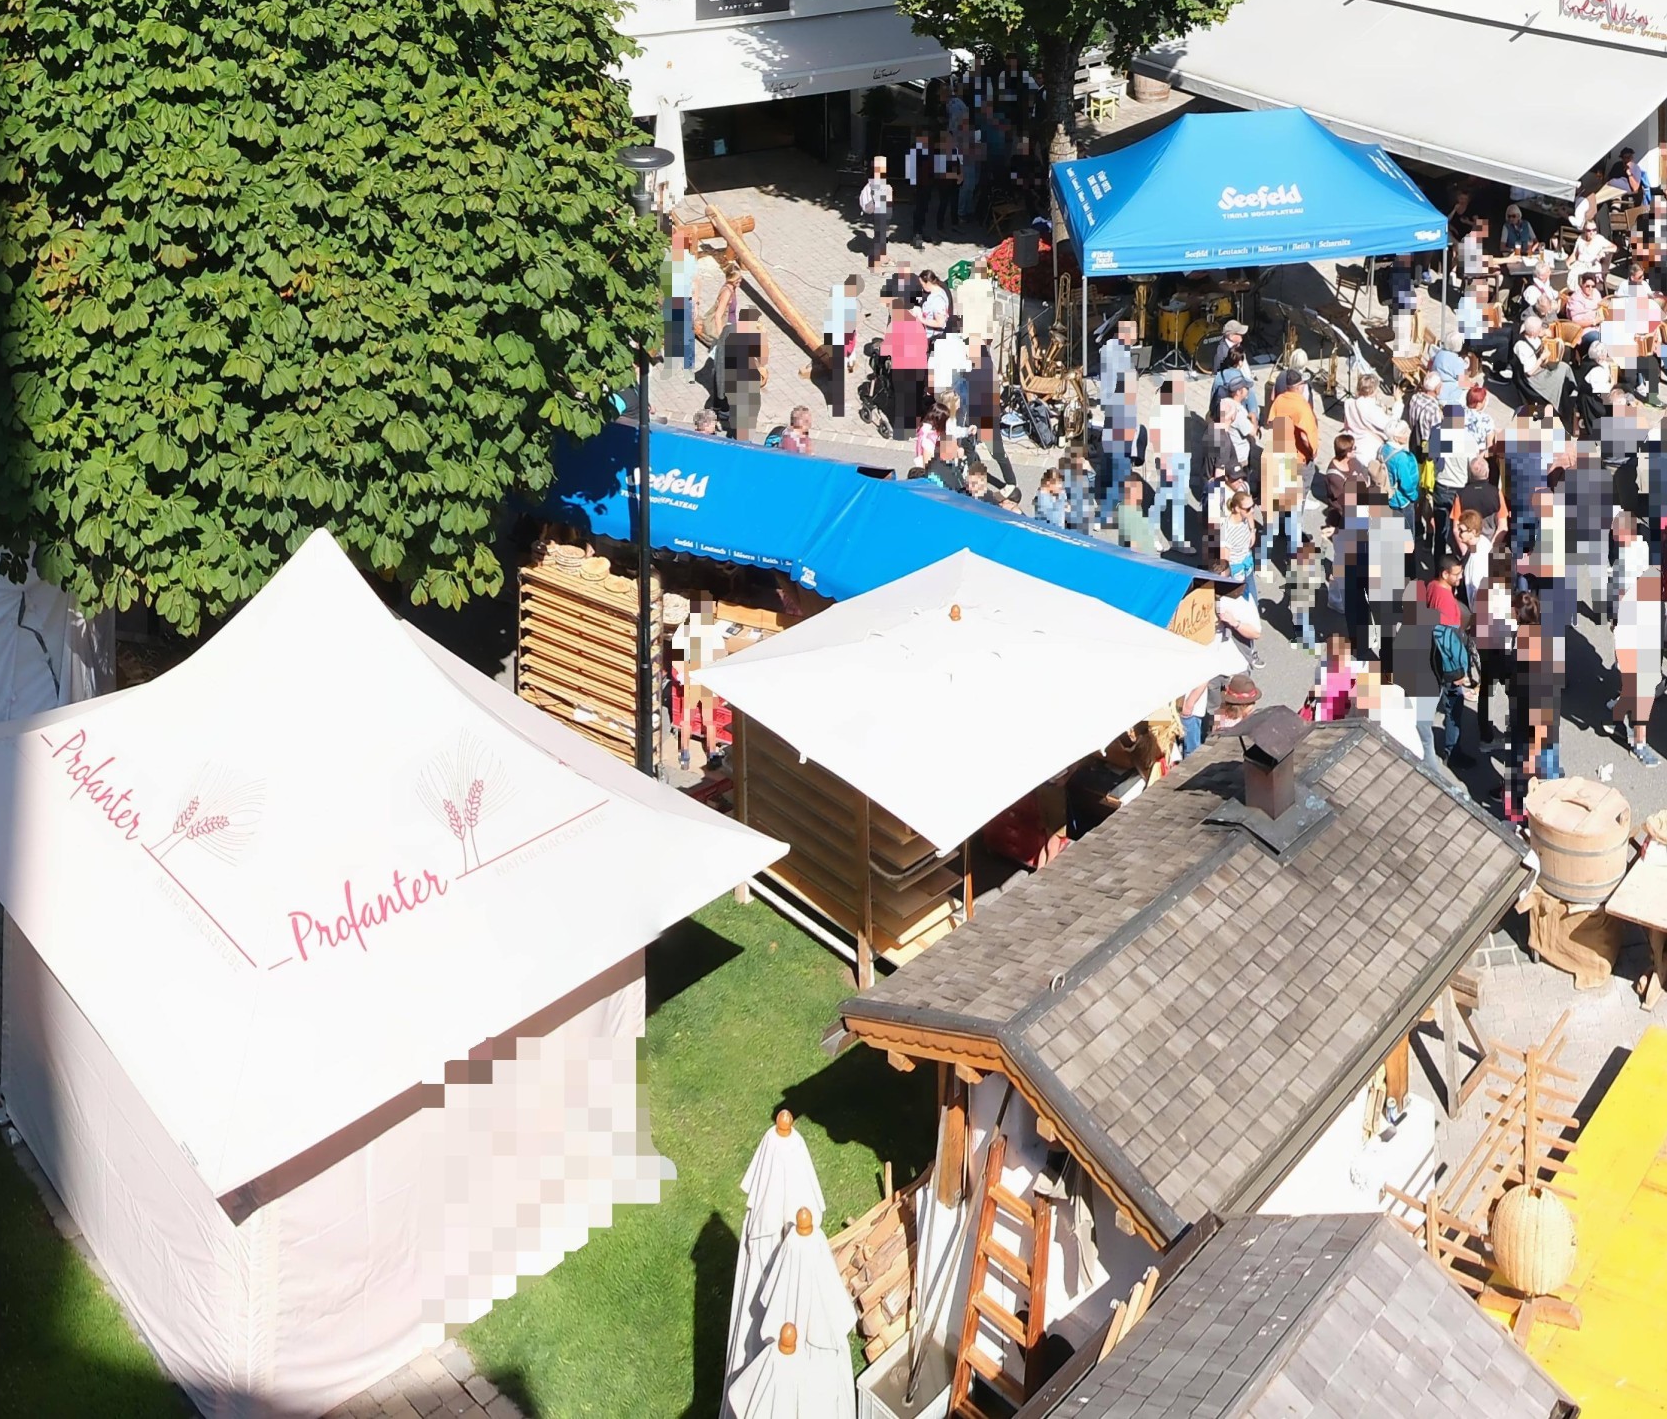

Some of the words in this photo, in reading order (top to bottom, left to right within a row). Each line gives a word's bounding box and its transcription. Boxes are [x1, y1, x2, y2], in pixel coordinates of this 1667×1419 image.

[1218, 184, 1303, 210] Seefeld
[52, 728, 142, 841] Profanter
[287, 869, 448, 962] Profanter
